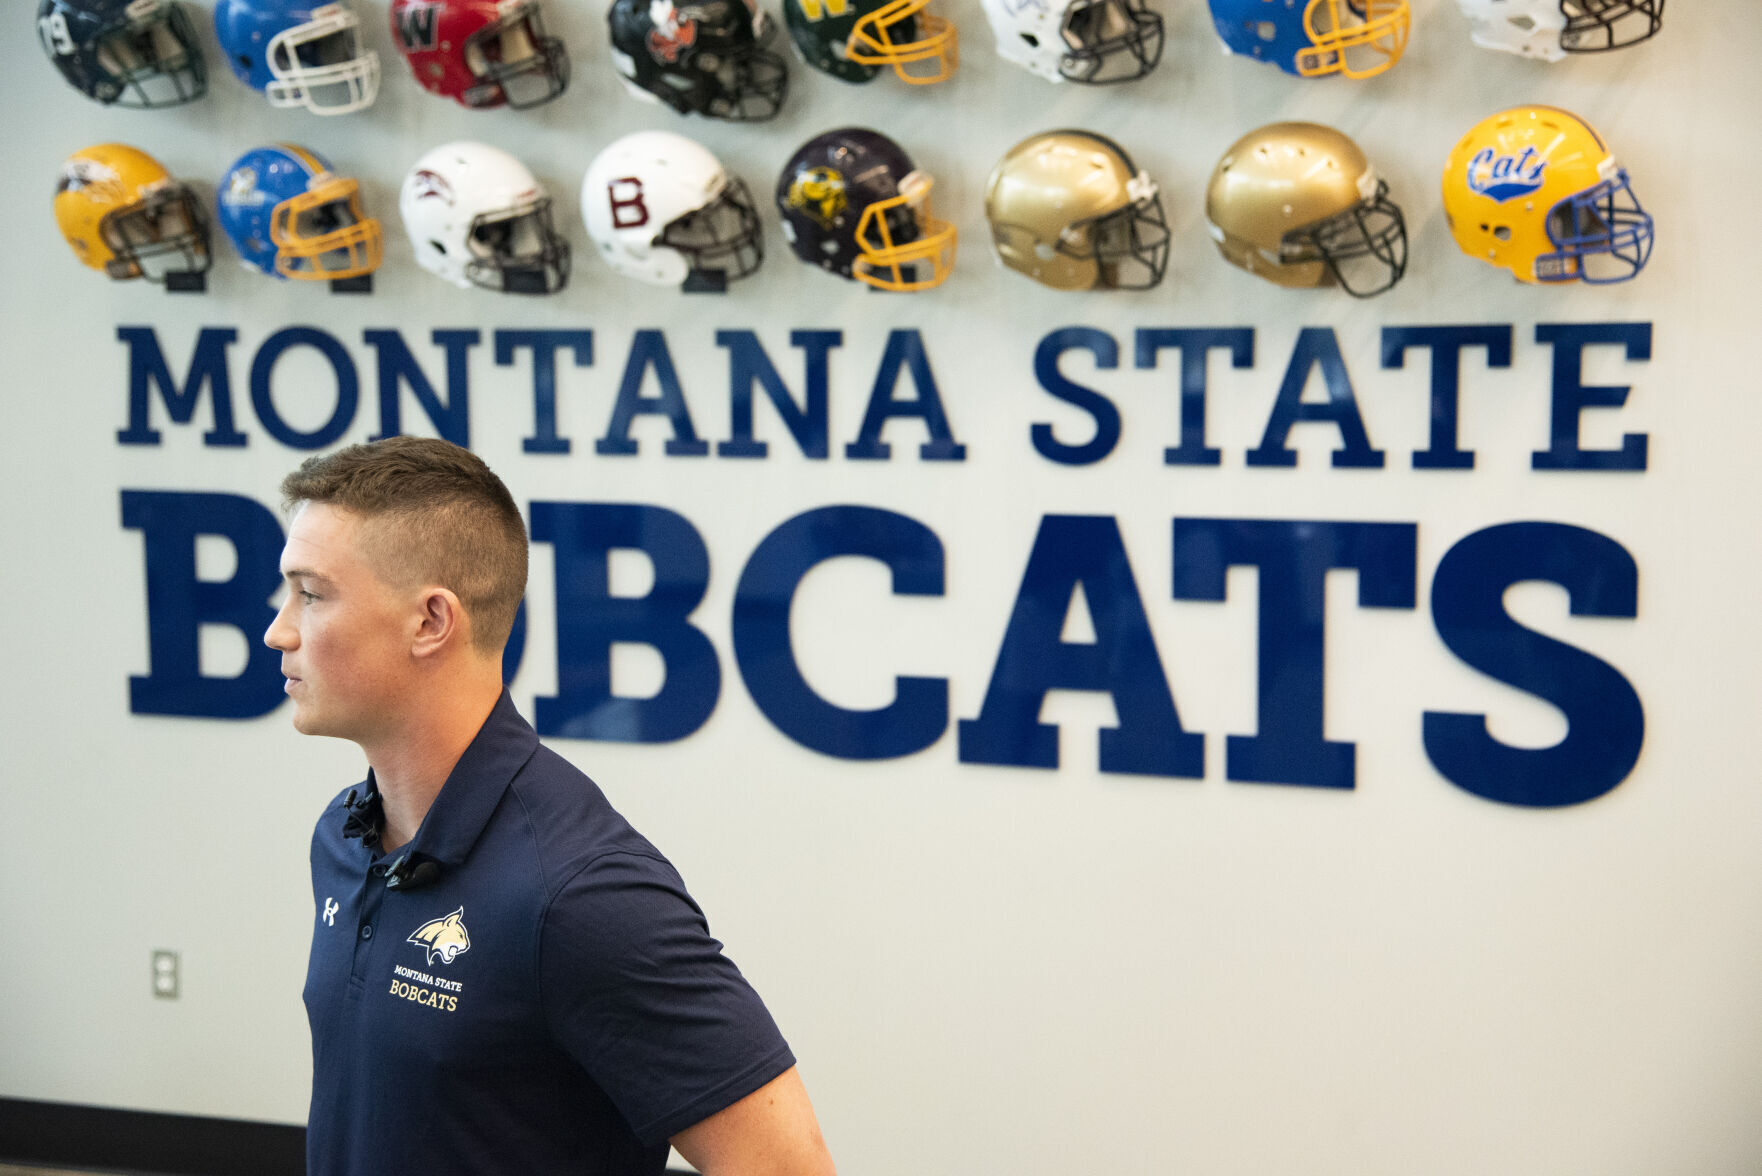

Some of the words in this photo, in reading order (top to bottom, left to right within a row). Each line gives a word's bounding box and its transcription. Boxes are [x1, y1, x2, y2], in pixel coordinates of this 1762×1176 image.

[395, 3, 443, 52] W
[1467, 147, 1546, 193] Cats
[608, 177, 649, 229] B
[116, 325, 967, 463] MONTANA
[1030, 322, 1653, 472] STATE
[120, 488, 1645, 809] BBCATS
[389, 979, 458, 1012] BOBCATS
[394, 965, 434, 985] MONTANA
[435, 977, 463, 993] STATE
